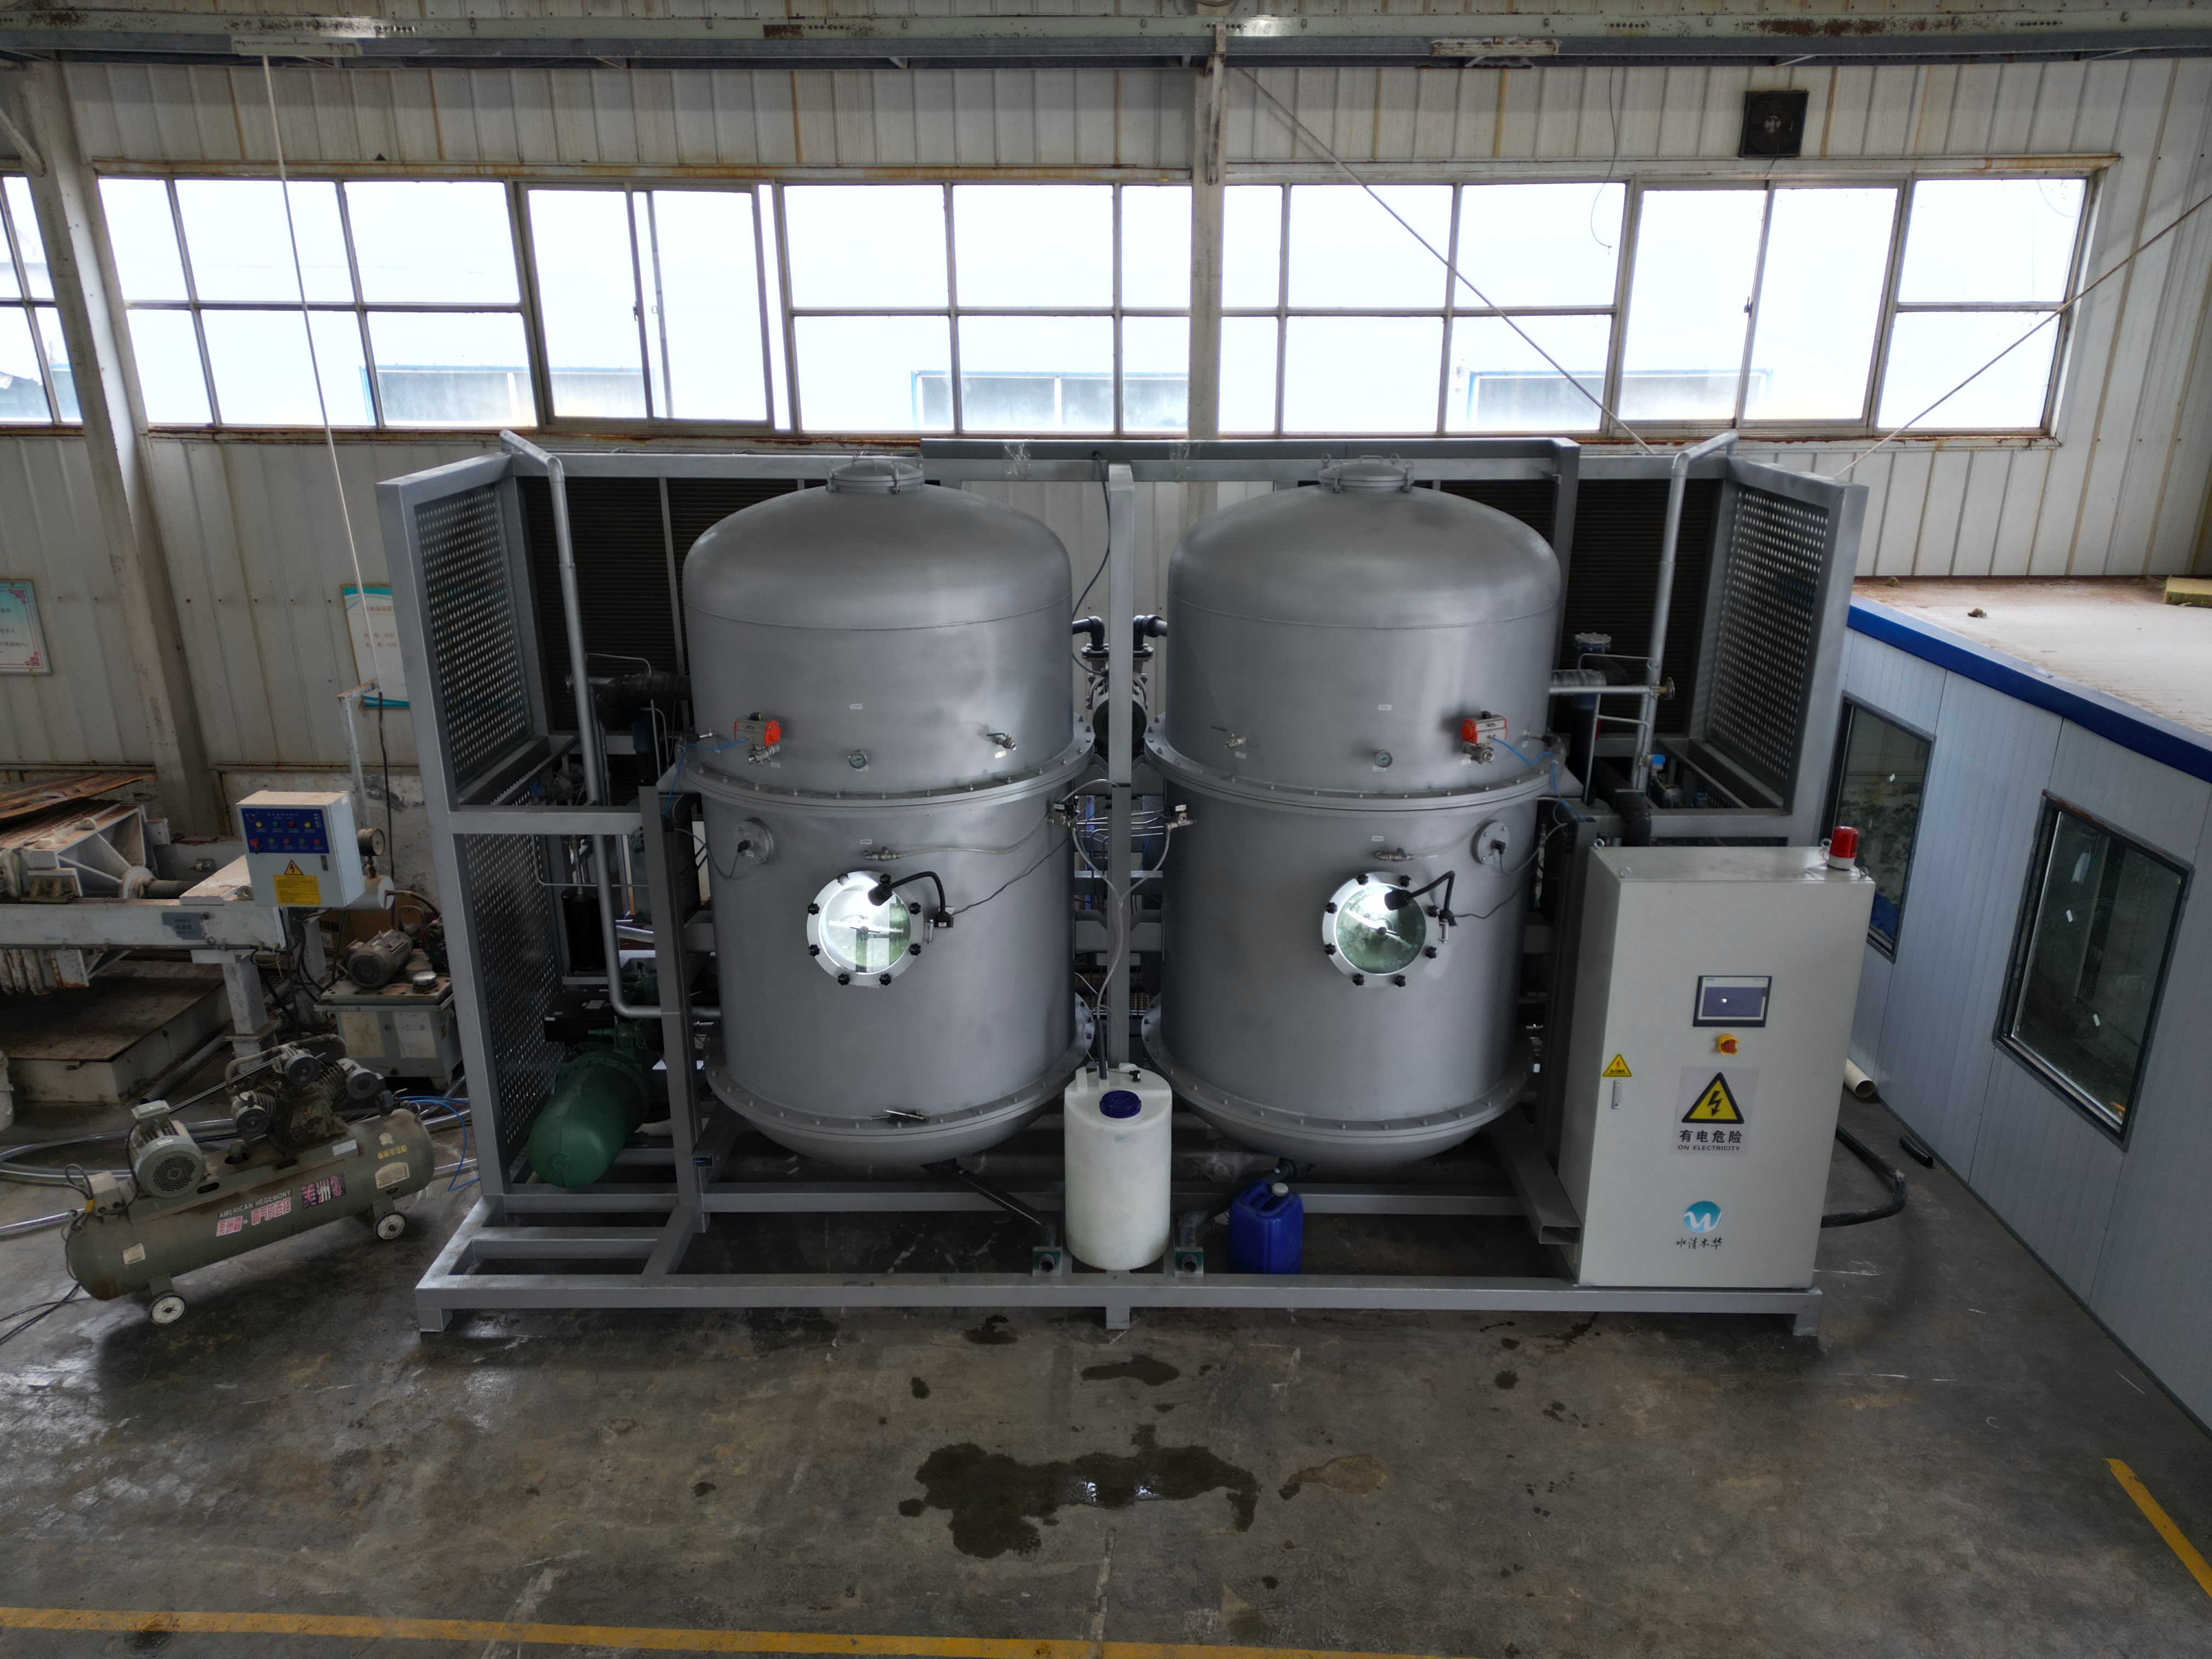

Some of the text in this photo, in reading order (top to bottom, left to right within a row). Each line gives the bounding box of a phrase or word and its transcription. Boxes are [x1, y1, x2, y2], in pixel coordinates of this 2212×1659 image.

[1680, 1130, 1742, 1143] 有电危险
[219, 1189, 291, 1218] AMERICAN HEGEMONY
[1676, 1237, 1723, 1250] 水清木华
